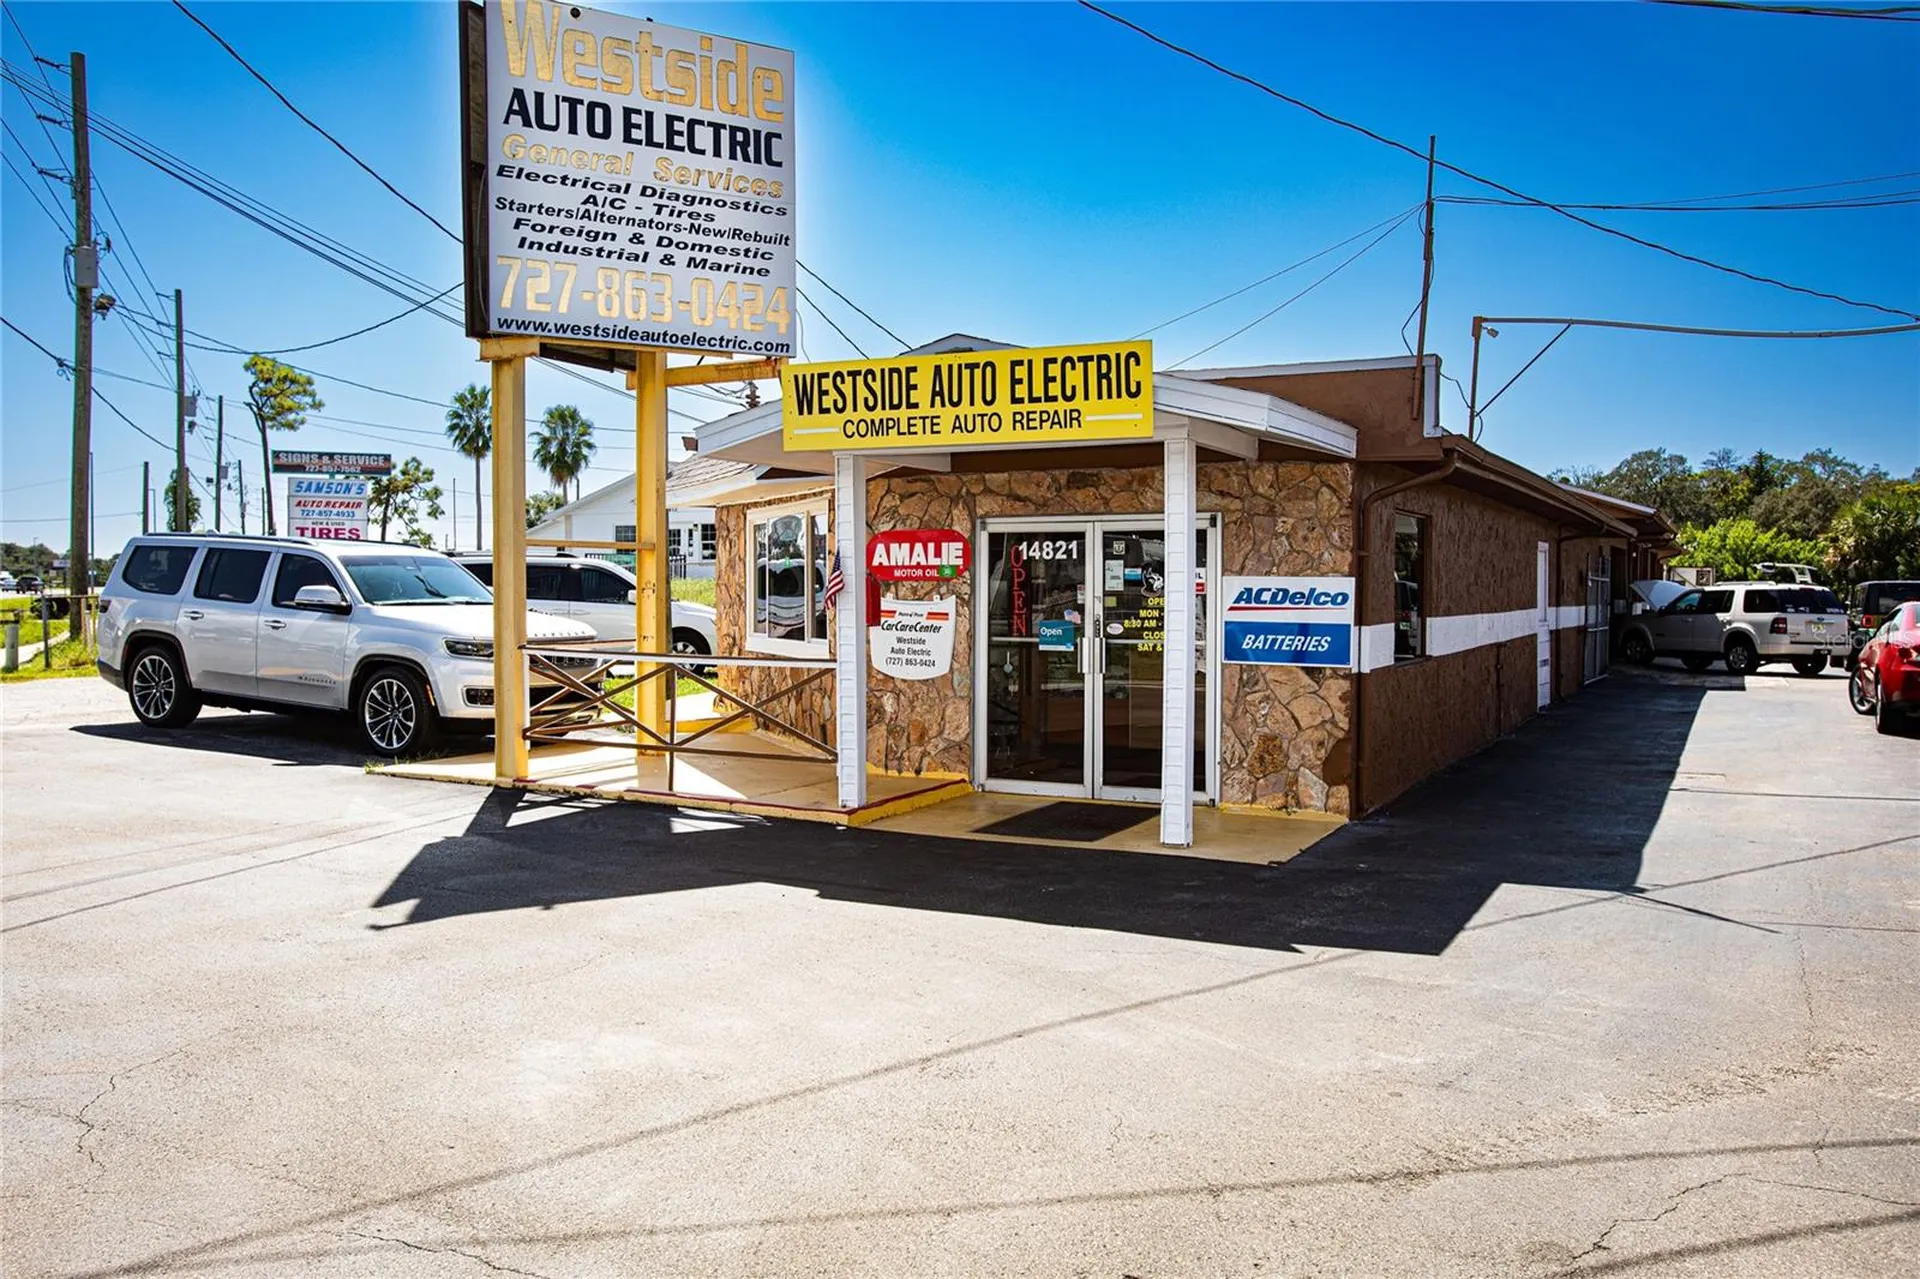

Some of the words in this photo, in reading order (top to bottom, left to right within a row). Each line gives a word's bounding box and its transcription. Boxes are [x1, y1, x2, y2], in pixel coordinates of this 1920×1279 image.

[501, 0, 785, 123] Westside
[503, 87, 612, 140] AUTO
[622, 106, 783, 167] ELECTRIC
[502, 133, 634, 176] General
[653, 156, 784, 199] Services
[496, 164, 632, 195] Electrical
[639, 185, 788, 216] Diagnostics
[580, 194, 627, 210] A/C
[653, 203, 716, 223] Tires
[513, 217, 617, 242] Foreign
[628, 232, 645, 246] &
[655, 235, 775, 261] Domestic
[517, 236, 649, 263] Industrial
[659, 253, 676, 267] &
[686, 256, 771, 277] Marine
[496, 255, 791, 335] 727-863-0424
[496, 317, 791, 354] www.westsideautoelectric.com
[794, 366, 918, 416] WESTSIDE
[930, 361, 996, 409] AUTO
[1010, 351, 1142, 405] ELECTRIC
[843, 415, 941, 439] COMPLETE
[951, 412, 1002, 434] AUTO
[1013, 408, 1082, 431] REPAIR
[279, 452, 319, 463] SIGNS
[334, 454, 385, 466] SERVICE
[295, 480, 365, 495] SAMSON'S
[296, 500, 323, 508] AUTO
[324, 500, 363, 509] REPAIR
[295, 526, 361, 539] TIRES
[872, 542, 964, 566] AMALIE
[1019, 540, 1077, 560] 14821
[894, 568, 923, 578] MOTOR
[925, 568, 939, 577] OIL
[1010, 545, 1026, 636] OPEN
[1233, 587, 1350, 606] ACDelco
[1147, 597, 1164, 606] OPE
[1139, 609, 1159, 618] MON
[1040, 627, 1063, 637] Open
[1124, 619, 1142, 628] 8:30
[1143, 619, 1157, 628] AM
[896, 636, 926, 645] Westside
[1143, 631, 1165, 640] CLOS
[1242, 634, 1331, 652] BATTERIES
[890, 646, 905, 655] Auto
[907, 647, 931, 656] Electric
[1137, 642, 1153, 651] SAT
[885, 656, 903, 667] (727)
[905, 658, 936, 668] 863-0424
